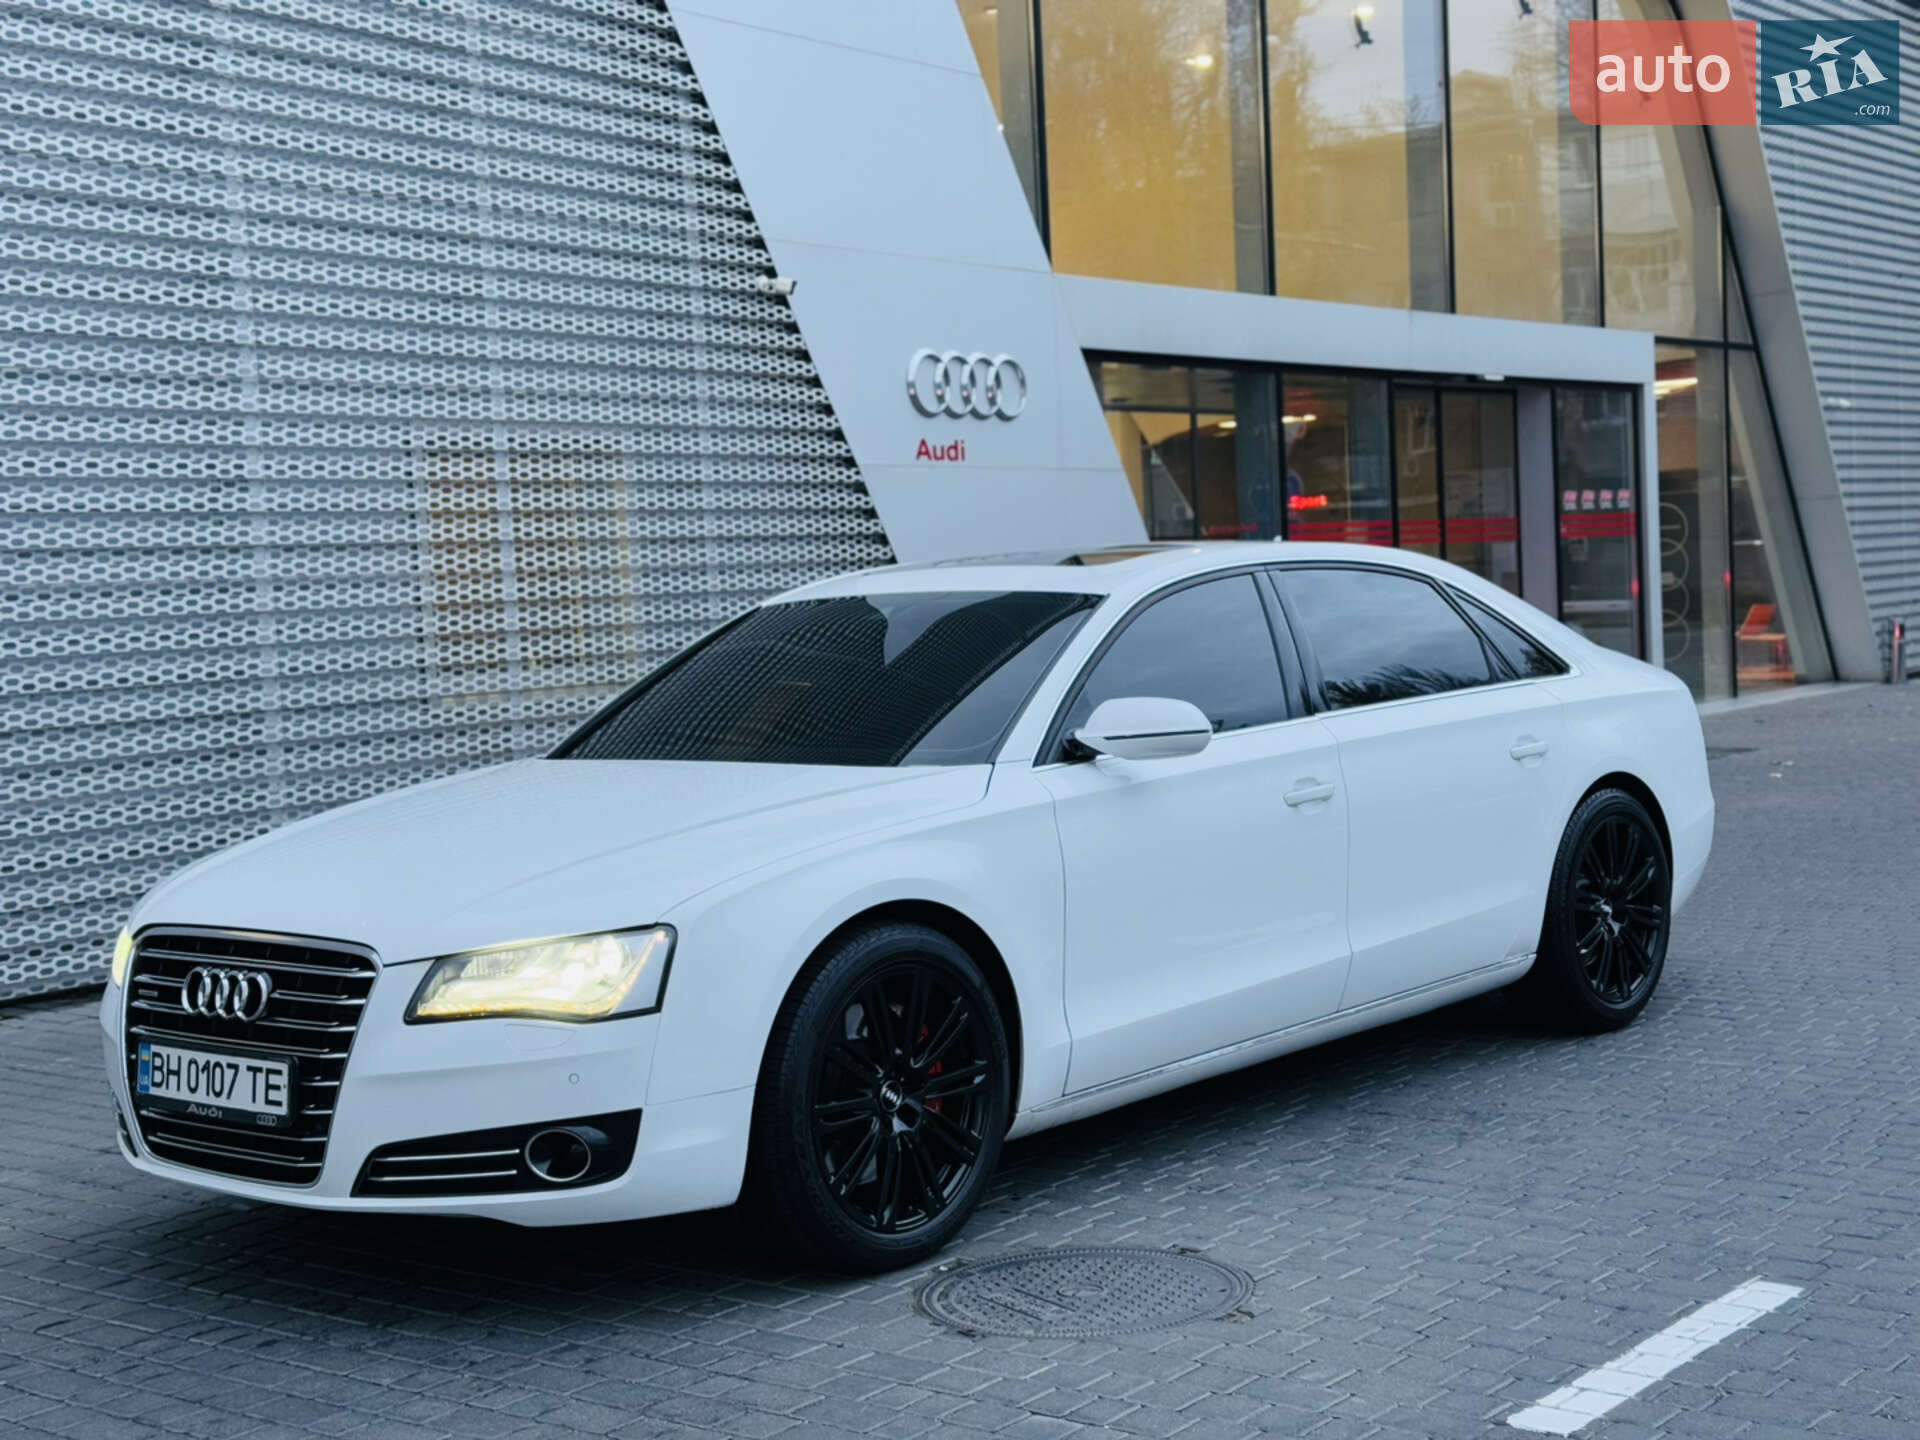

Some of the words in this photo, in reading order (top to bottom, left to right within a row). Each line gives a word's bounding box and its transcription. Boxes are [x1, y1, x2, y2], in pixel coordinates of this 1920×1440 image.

[916, 438, 966, 461] Audi
[151, 1051, 182, 1092] BH
[187, 1057, 240, 1100] 0107
[246, 1064, 283, 1107] TE
